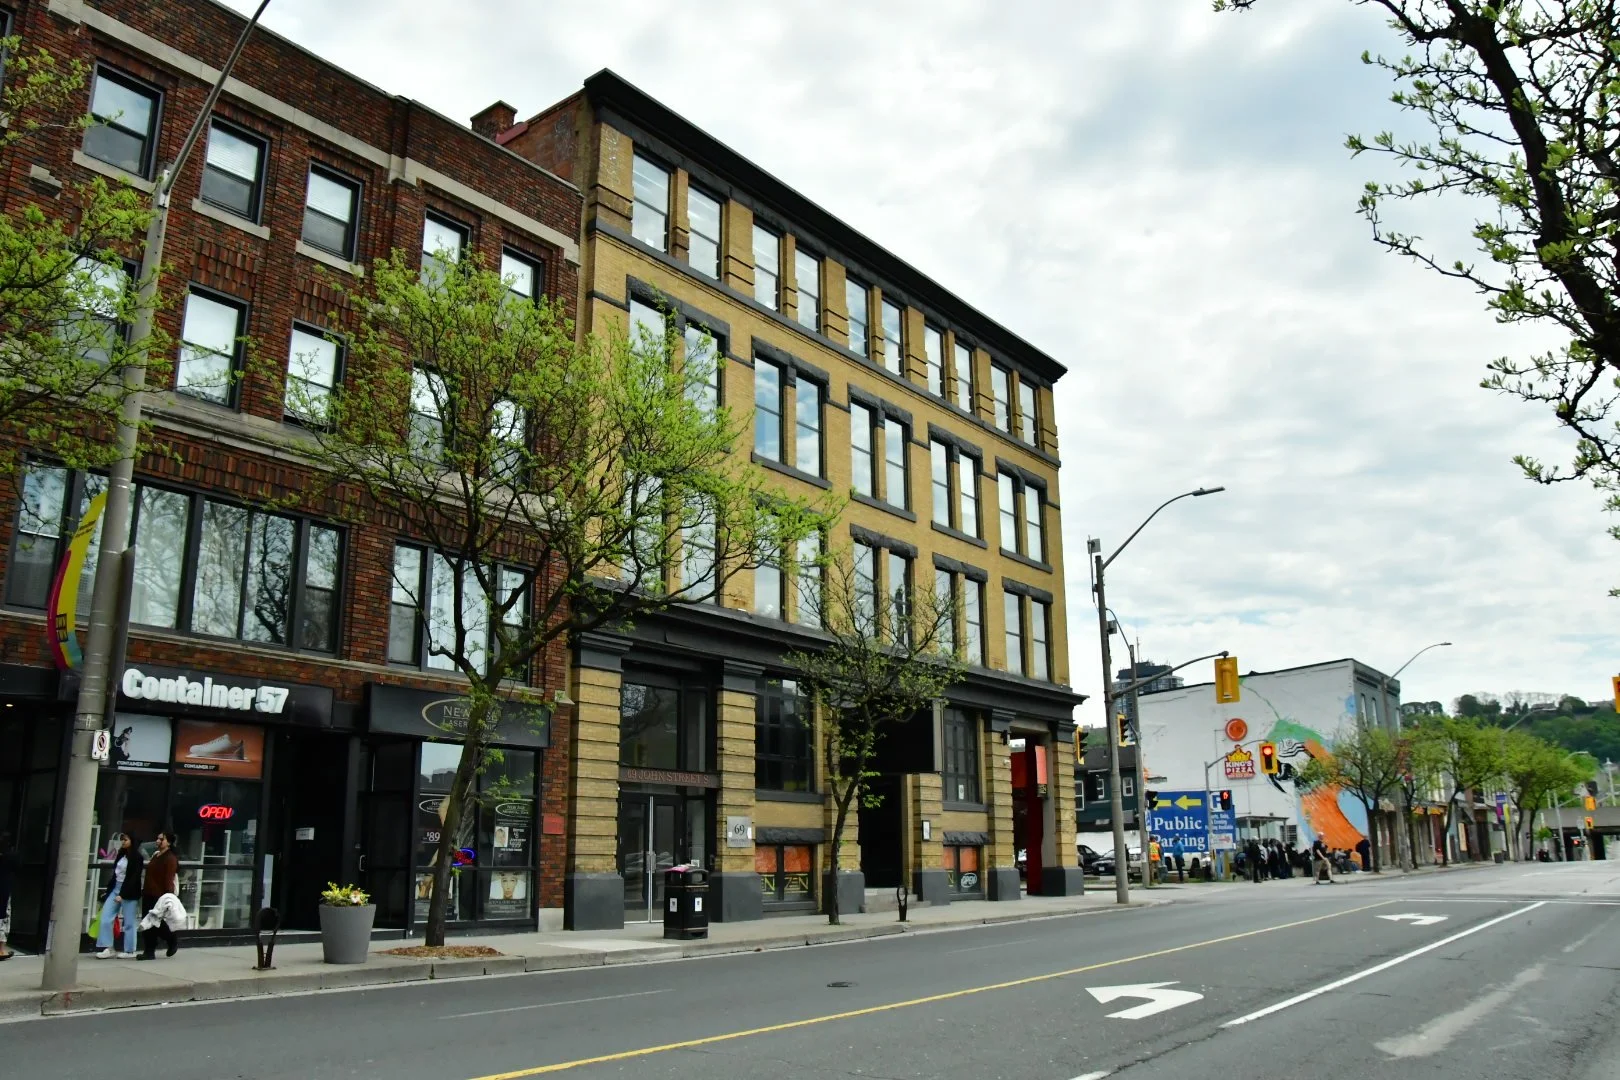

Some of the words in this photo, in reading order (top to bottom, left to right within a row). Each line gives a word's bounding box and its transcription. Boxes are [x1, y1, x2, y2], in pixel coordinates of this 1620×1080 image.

[122, 668, 256, 710] Container
[255, 685, 289, 713] 57
[638, 770, 664, 780] JOHN
[666, 772, 702, 784] STREET
[200, 805, 232, 819] OPEN
[734, 824, 745, 835] 69
[1153, 816, 1203, 831] Public
[1151, 833, 1206, 851] Paring
